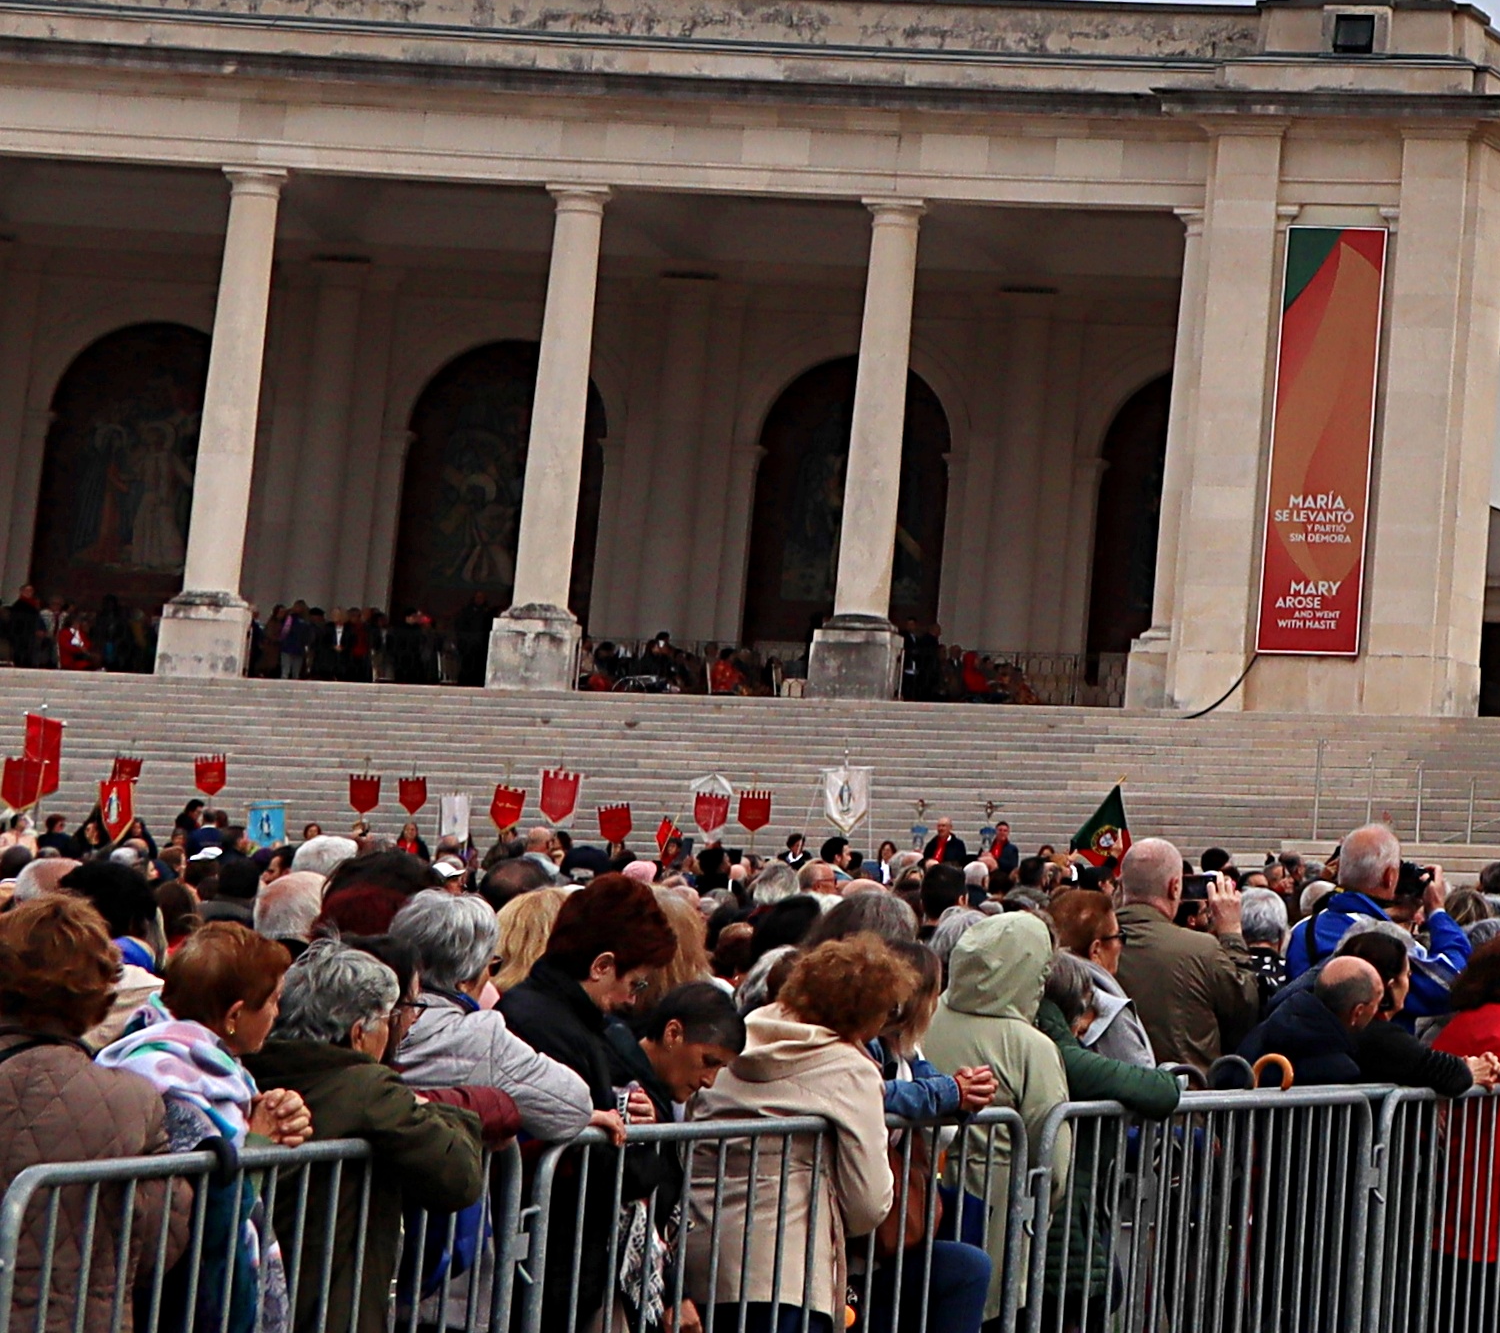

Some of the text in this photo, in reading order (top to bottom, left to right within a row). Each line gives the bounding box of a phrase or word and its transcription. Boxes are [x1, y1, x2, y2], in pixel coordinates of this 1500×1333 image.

[1289, 490, 1345, 509] MARÍA
[1274, 508, 1354, 523] SE LEVANTÓ
[1314, 523, 1346, 533] PARTIÓ
[1290, 533, 1351, 543] SIN DEMORA
[1290, 580, 1342, 596] MARY
[1275, 596, 1322, 609] AROSE
[1294, 610, 1340, 619] AND WENT
[1277, 619, 1337, 630] WITH HASTE
